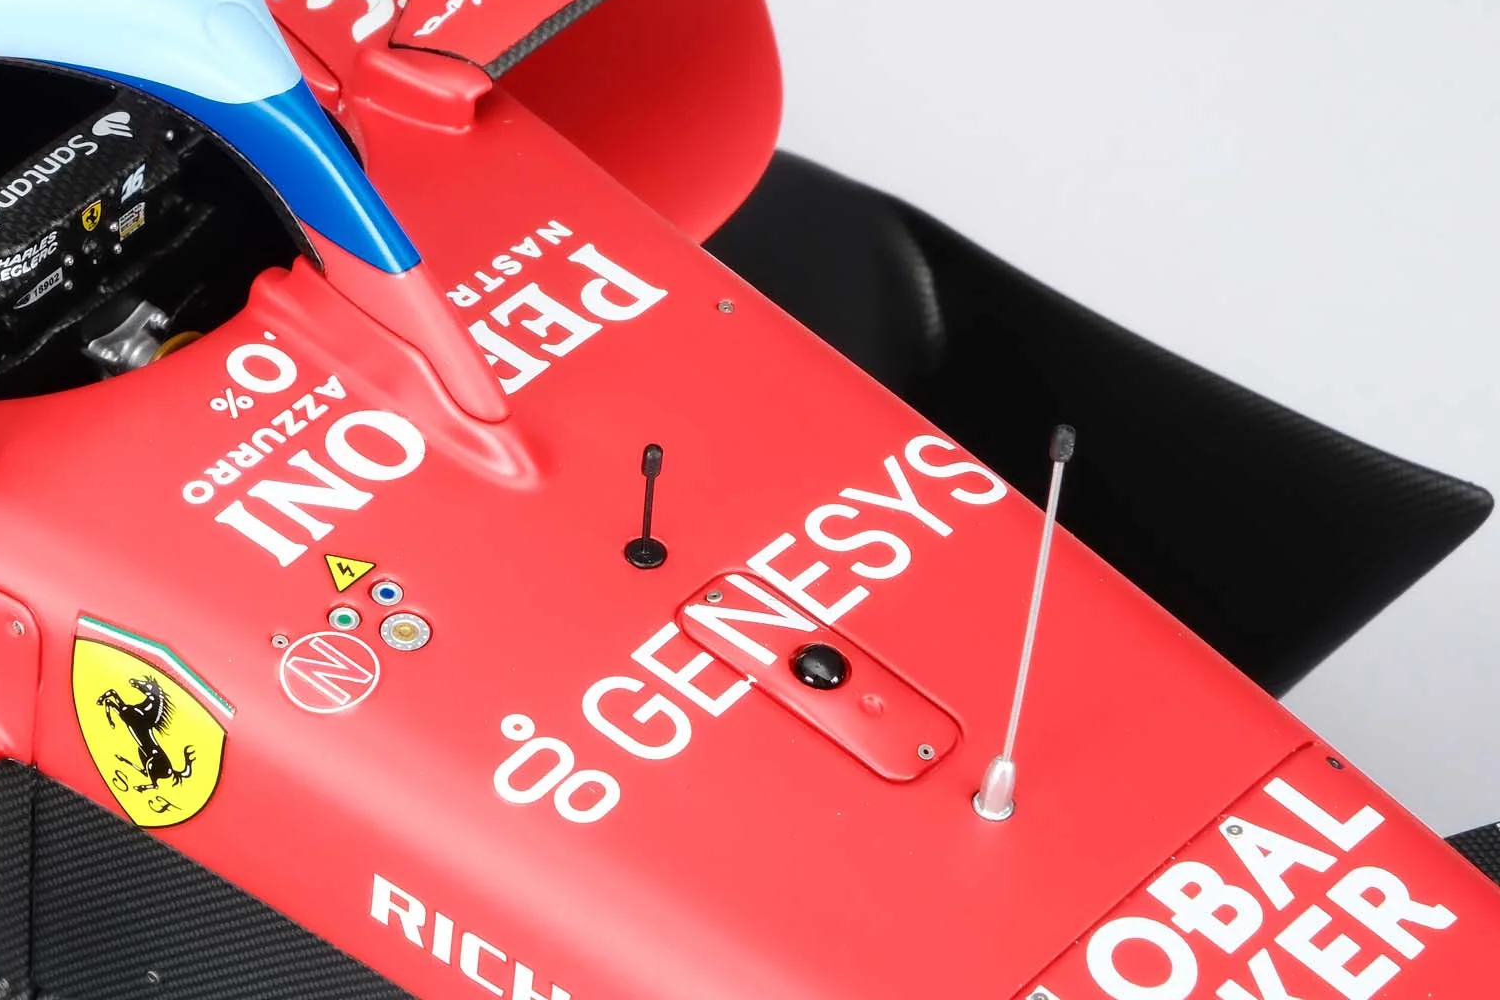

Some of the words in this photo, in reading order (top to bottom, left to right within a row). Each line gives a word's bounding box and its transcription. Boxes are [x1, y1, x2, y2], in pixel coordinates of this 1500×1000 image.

[445, 219, 573, 309] NASTR
[182, 374, 347, 504] AZZURRO
[209, 330, 298, 420] .0%
[581, 433, 1008, 761] GENESYS
[1025, 777, 1386, 1000] OBAL
